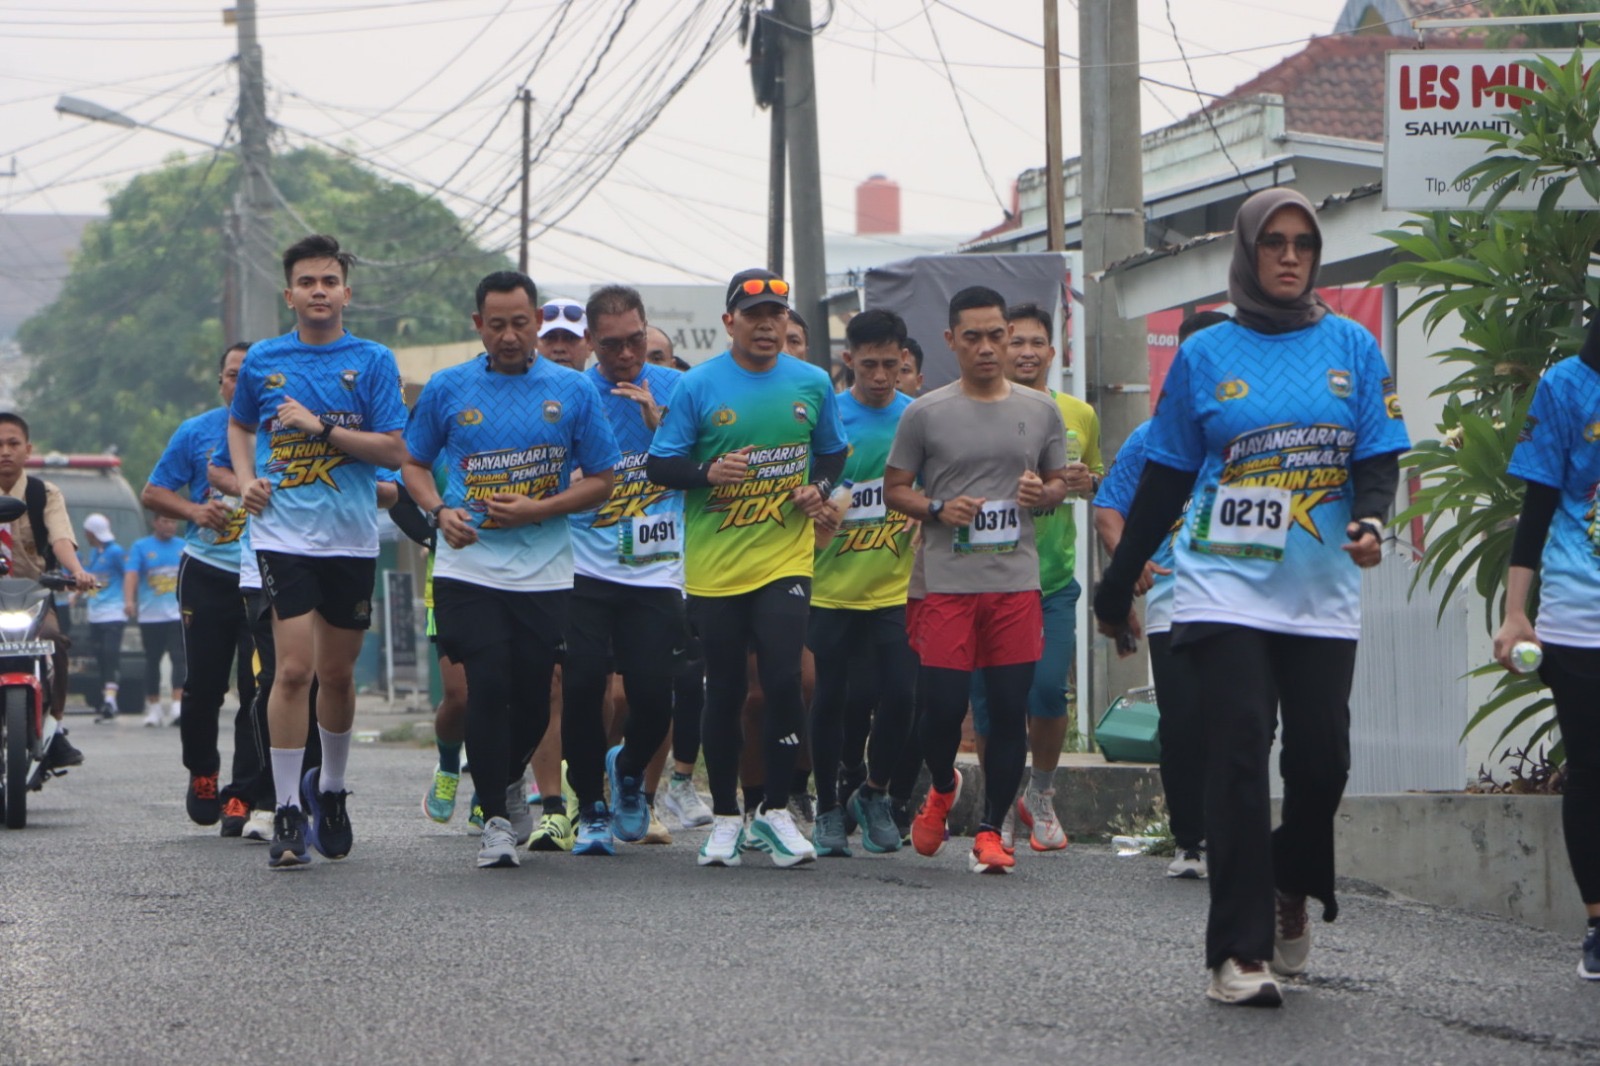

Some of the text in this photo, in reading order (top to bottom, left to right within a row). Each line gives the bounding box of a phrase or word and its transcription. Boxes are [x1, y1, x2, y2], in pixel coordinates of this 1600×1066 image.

[1400, 65, 1460, 110] LES
[1425, 177, 1450, 195] Tlp.
[294, 442, 327, 458] RUN
[278, 455, 344, 493] 5K
[757, 463, 795, 479] PEMKAB
[610, 480, 643, 500] RUN
[706, 482, 740, 504] FUN
[740, 479, 774, 497] RUN
[592, 492, 662, 528] 5K
[716, 490, 789, 533] 10K
[974, 508, 1018, 531] 0374
[1220, 498, 1283, 529] 0213
[1286, 489, 1337, 544] K
[638, 520, 675, 544] 0491
[836, 522, 904, 558] 10K
